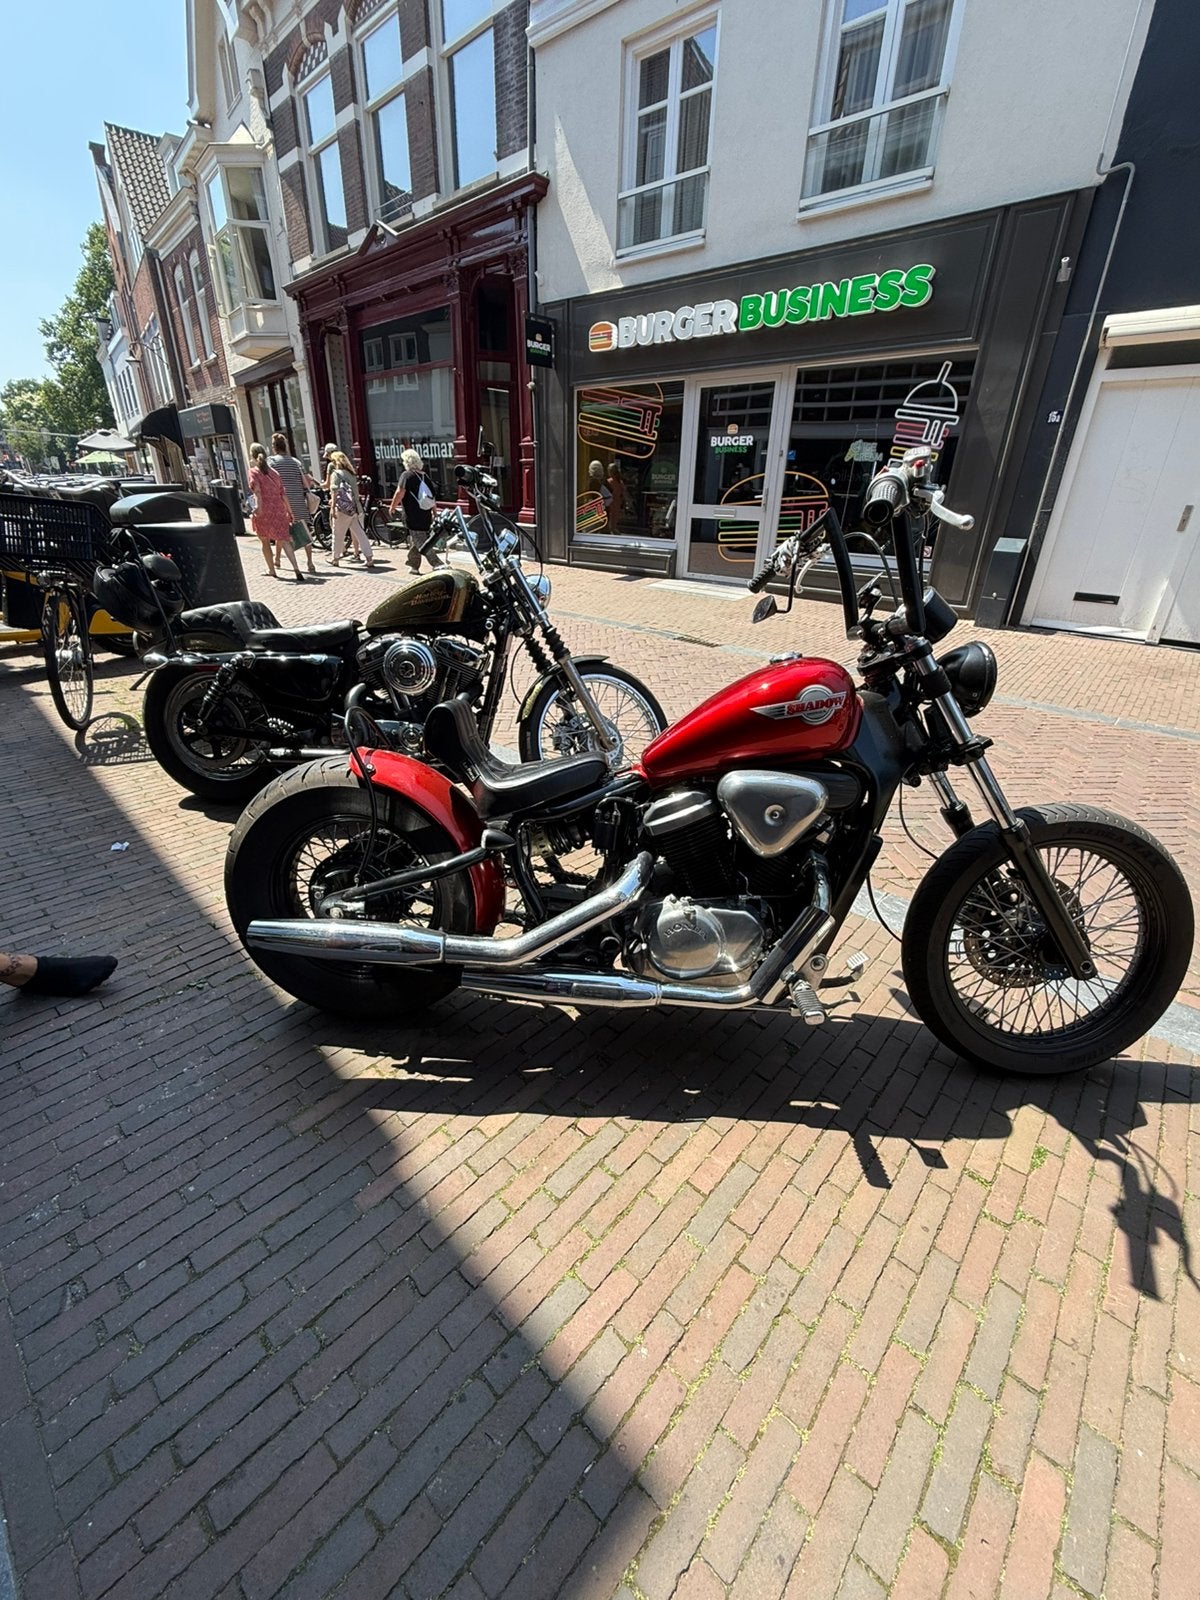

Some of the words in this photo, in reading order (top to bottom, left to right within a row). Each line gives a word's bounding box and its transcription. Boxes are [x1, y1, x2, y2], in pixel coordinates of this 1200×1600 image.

[617, 299, 738, 349] BURGER
[738, 263, 936, 331] BUSINESS
[526, 339, 551, 352] BURGER
[375, 438, 406, 459] studio
[710, 434, 753, 447] BURGER
[714, 446, 748, 454] BUSINESS
[786, 695, 845, 715] SHADOW
